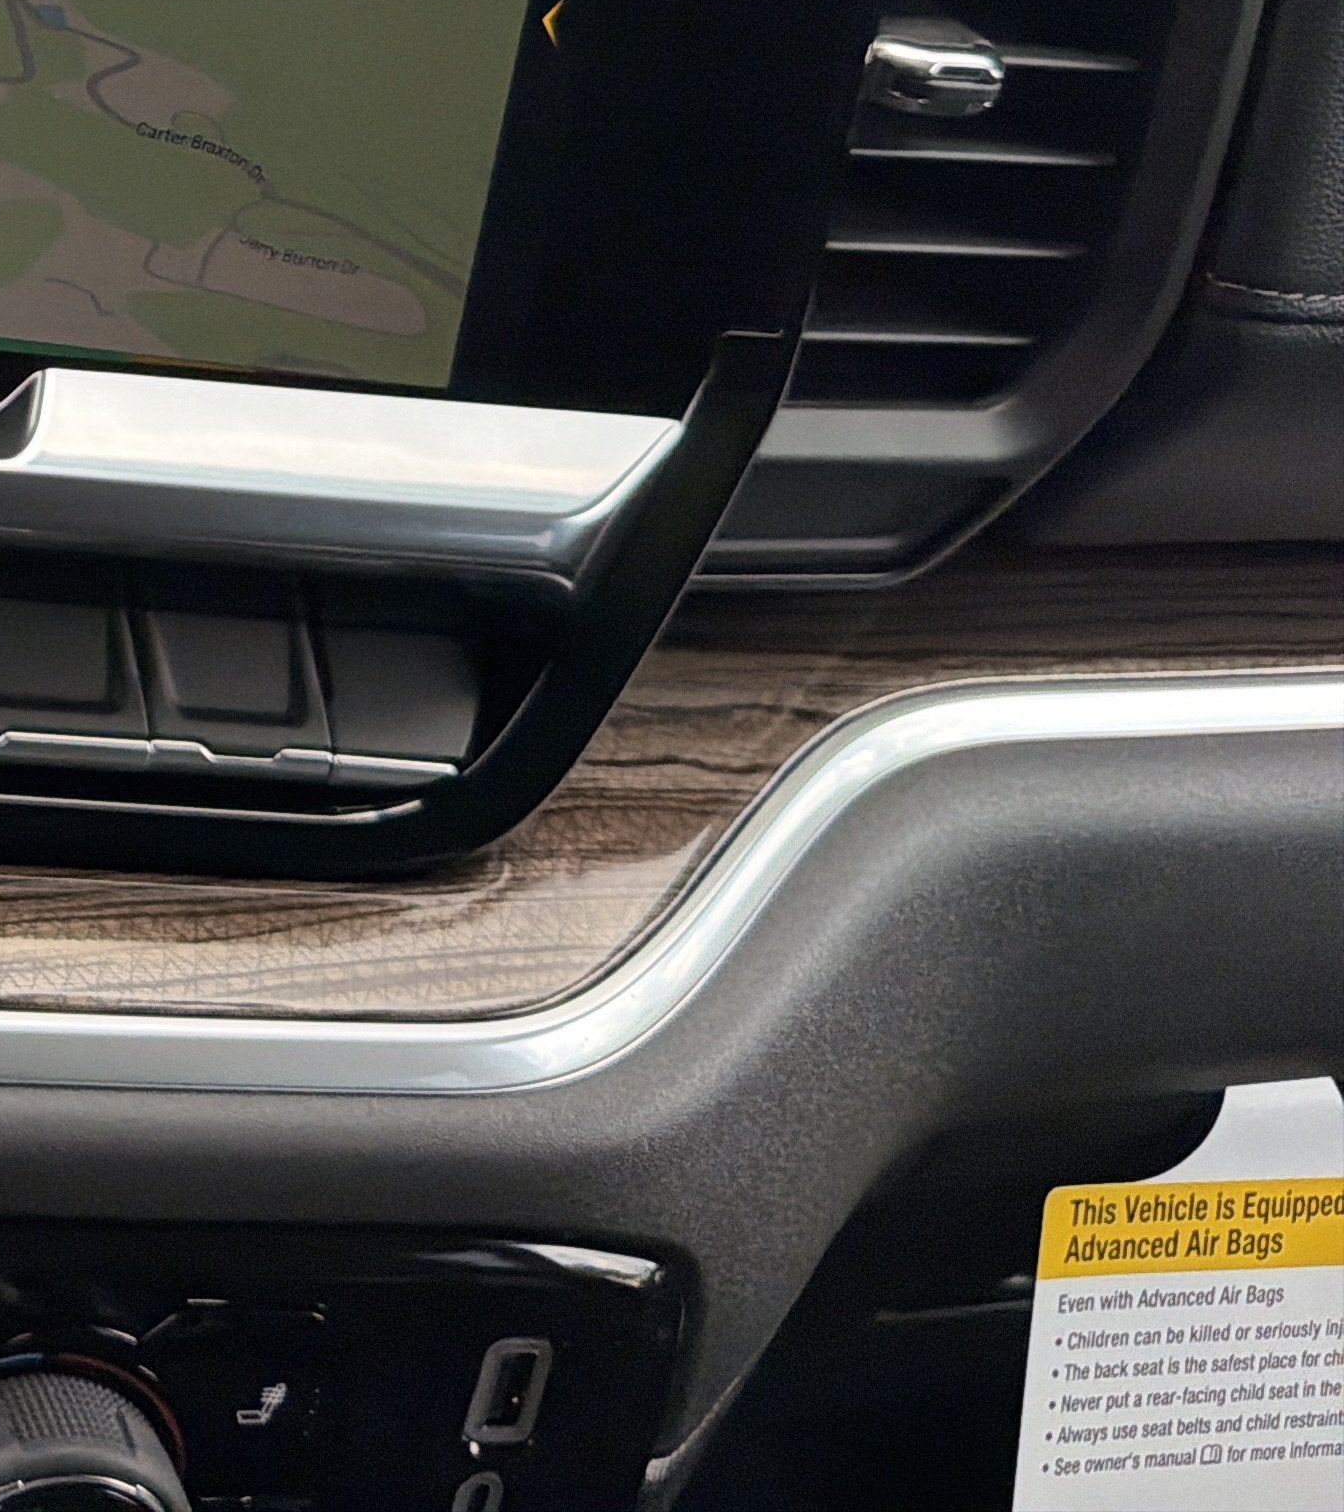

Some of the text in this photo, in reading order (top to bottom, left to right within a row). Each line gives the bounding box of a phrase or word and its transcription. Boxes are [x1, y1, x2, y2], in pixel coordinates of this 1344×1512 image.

[136, 122, 266, 184] Carter Braxton Dr
[1070, 1196, 1116, 1227] This
[1126, 1193, 1208, 1224] Vehicle
[1215, 1192, 1235, 1220] is
[1064, 1228, 1283, 1263] Advanced Air Bags
[1058, 1285, 1285, 1314] Even with Advanced Air Bags
[1067, 1330, 1129, 1350] Children
[1134, 1330, 1161, 1346] can
[1166, 1327, 1184, 1343] be
[1190, 1324, 1230, 1342] killed
[1235, 1325, 1251, 1338] or
[1256, 1319, 1321, 1340] seriously
[1064, 1363, 1089, 1381] The
[1094, 1360, 1128, 1379] back
[1133, 1361, 1164, 1376] seat
[1168, 1357, 1180, 1374] is
[1185, 1356, 1207, 1373] the
[1211, 1354, 1255, 1372] safest
[1259, 1352, 1296, 1373] place
[1302, 1350, 1320, 1367] for
[1061, 1380, 1341, 1413] Never put a rear-facing child seat in the
[1057, 1425, 1108, 1445] Always
[1113, 1425, 1137, 1439] use
[1142, 1420, 1172, 1436] seat
[1176, 1417, 1211, 1436] belts
[1215, 1415, 1242, 1433] and
[1246, 1412, 1280, 1432] child
[1054, 1458, 1080, 1476] See
[1084, 1454, 1140, 1473] owner's
[1144, 1449, 1197, 1468] manual
[1227, 1445, 1247, 1462] for
[1250, 1445, 1286, 1460] more
